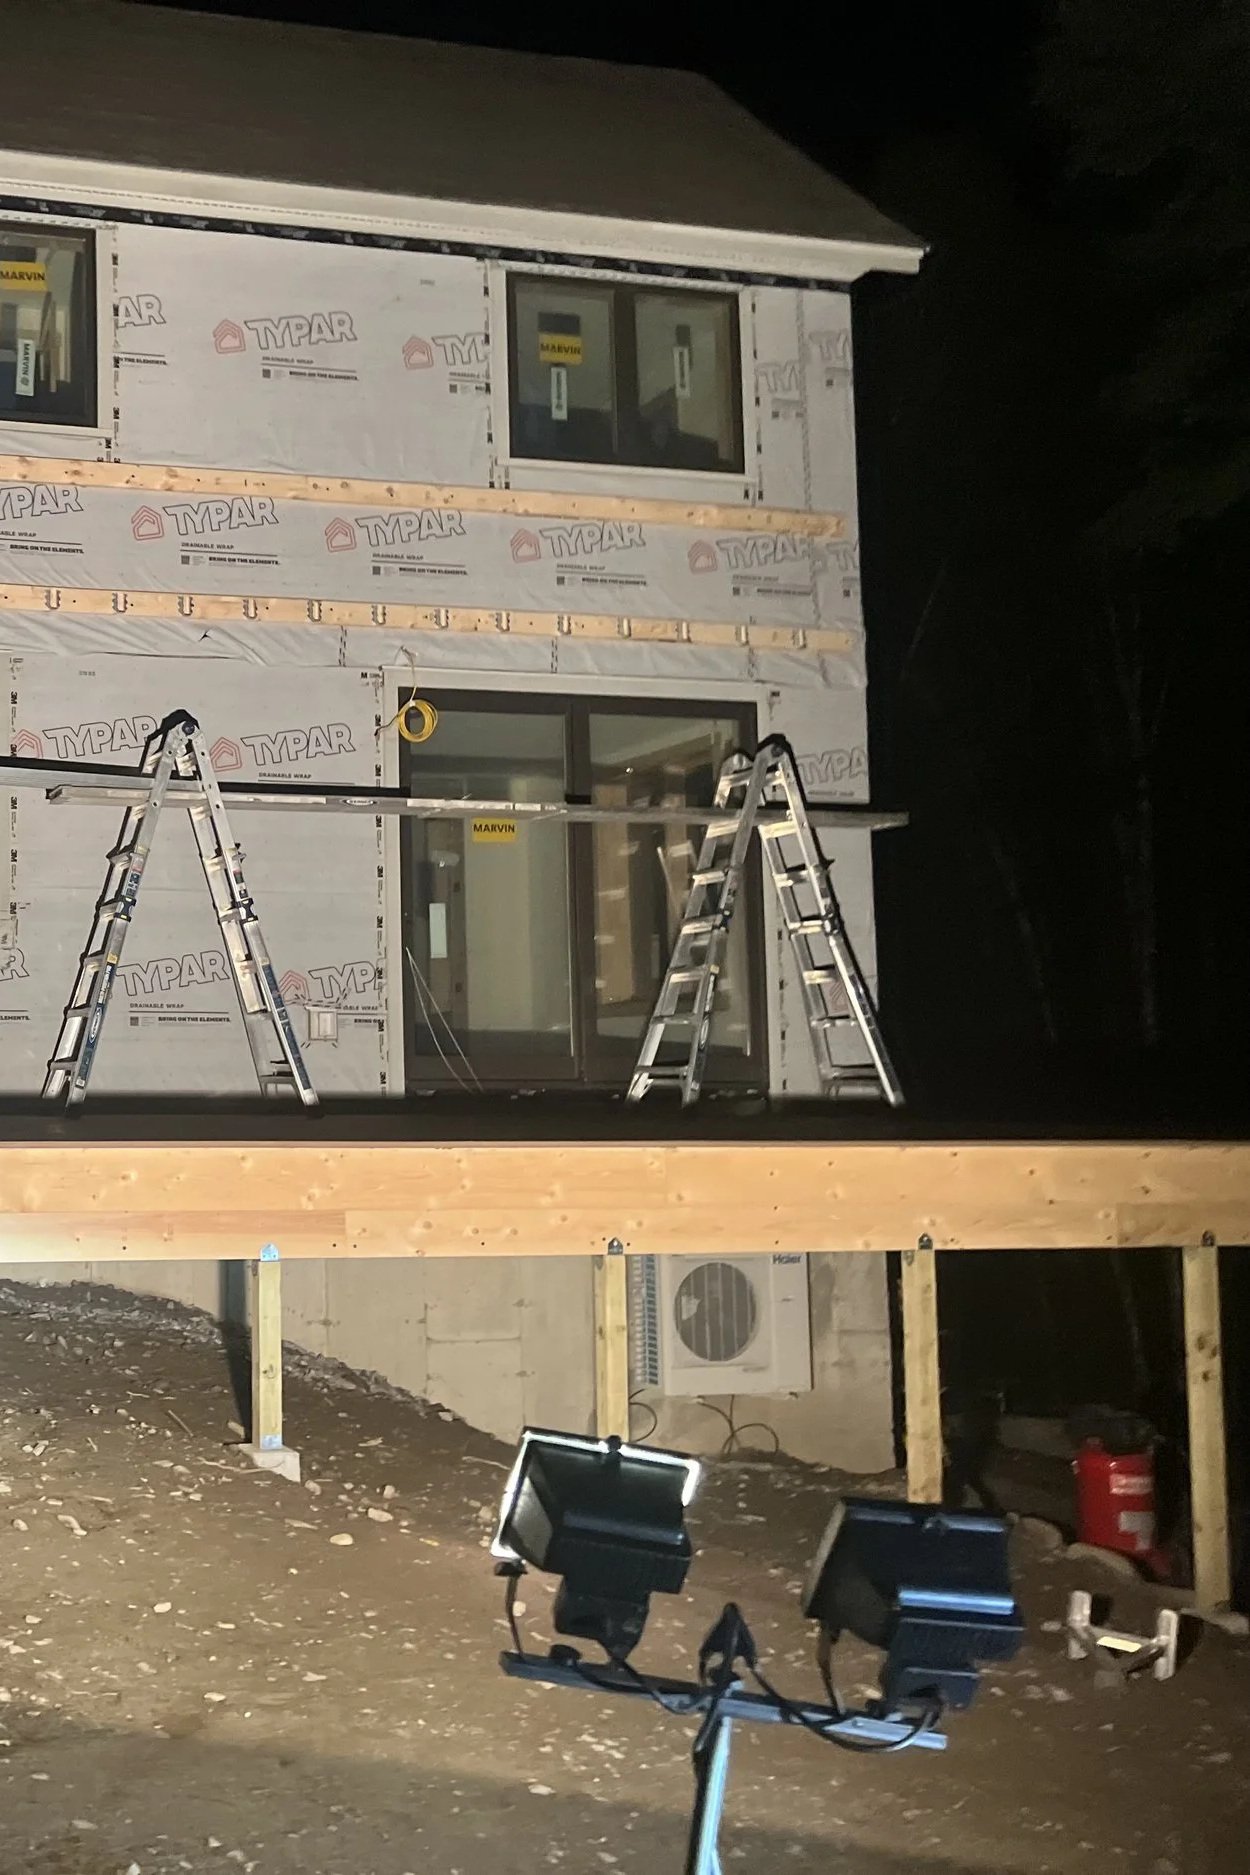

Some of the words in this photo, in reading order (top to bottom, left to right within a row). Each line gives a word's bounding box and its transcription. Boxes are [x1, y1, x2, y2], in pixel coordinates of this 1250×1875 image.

[244, 310, 358, 350] TYPAR
[431, 332, 486, 366] TYP
[540, 342, 581, 355] MARVIN
[21, 342, 30, 376] MARVIN
[113, 407, 120, 420] 3M
[162, 496, 279, 536] TYPAR
[354, 508, 467, 547] TYPAR
[539, 520, 646, 558] TYPAR
[182, 542, 214, 550] DRAINABLE
[10, 692, 18, 704] 3M
[374, 714, 382, 727] 3M
[240, 722, 356, 766] TYPAR
[375, 764, 382, 776] 3M
[10, 796, 18, 810] 3M
[376, 815, 382, 828] 3M
[472, 822, 515, 834] MARVIN
[10, 848, 18, 862] 3M
[377, 865, 384, 878] 3M
[10, 902, 16, 914] 3M
[376, 916, 383, 928] 3M
[116, 950, 230, 996] TYPAR
[376, 967, 383, 980] 3M
[308, 961, 380, 999] TYP
[380, 1071, 386, 1084] 3M
